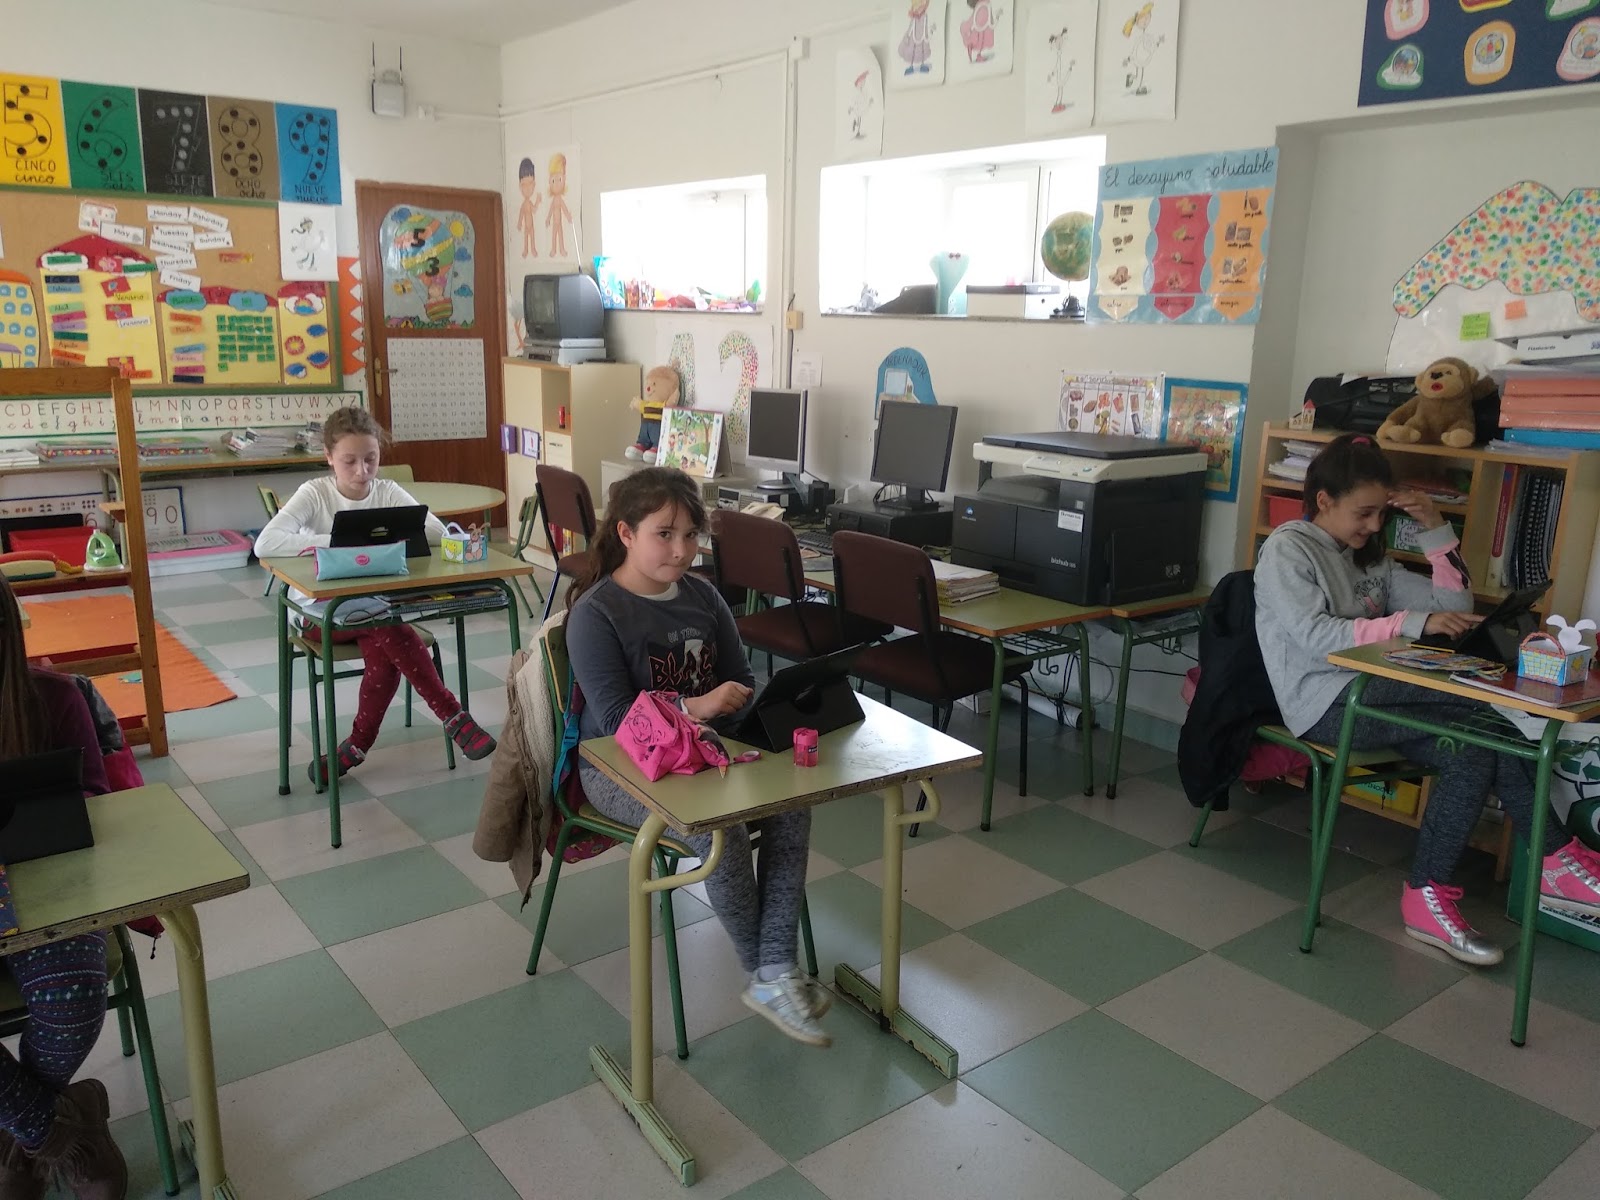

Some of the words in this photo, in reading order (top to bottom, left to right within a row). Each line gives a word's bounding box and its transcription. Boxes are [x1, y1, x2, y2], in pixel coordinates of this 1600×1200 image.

[3, 81, 52, 160] 5
[77, 92, 129, 171] 6
[217, 105, 264, 178] 8
[288, 111, 330, 181] 9
[15, 160, 56, 172] CINCO
[1104, 166, 1119, 188] El
[1127, 165, 1194, 194] desayuno
[1205, 148, 1275, 177] saludable
[15, 174, 55, 184] cinco
[153, 210, 182, 219] Monday
[160, 230, 189, 238] Tuesday
[411, 229, 426, 247] 5
[426, 257, 440, 276] 3
[170, 274, 192, 287] Friday
[4, 403, 15, 417] C
[20, 403, 31, 416] D
[37, 402, 46, 416] E
[51, 402, 60, 415] F
[65, 402, 76, 415] G
[81, 402, 92, 414] H
[97, 401, 104, 414] I
[135, 400, 143, 413] L
[150, 400, 161, 412] M
[167, 399, 178, 411] N
[198, 398, 209, 411] O
[214, 398, 223, 410] P
[228, 398, 238, 411] Q
[242, 397, 251, 409] R
[255, 397, 263, 410] S
[267, 397, 276, 409] T
[281, 396, 290, 409] U
[294, 396, 304, 409] V
[309, 396, 320, 408] W
[325, 395, 334, 408] X
[338, 396, 345, 407] Y
[349, 395, 357, 407] Z
[146, 507, 157, 525] 9
[165, 505, 178, 524] 0
[1050, 556, 1069, 567] bizhub
